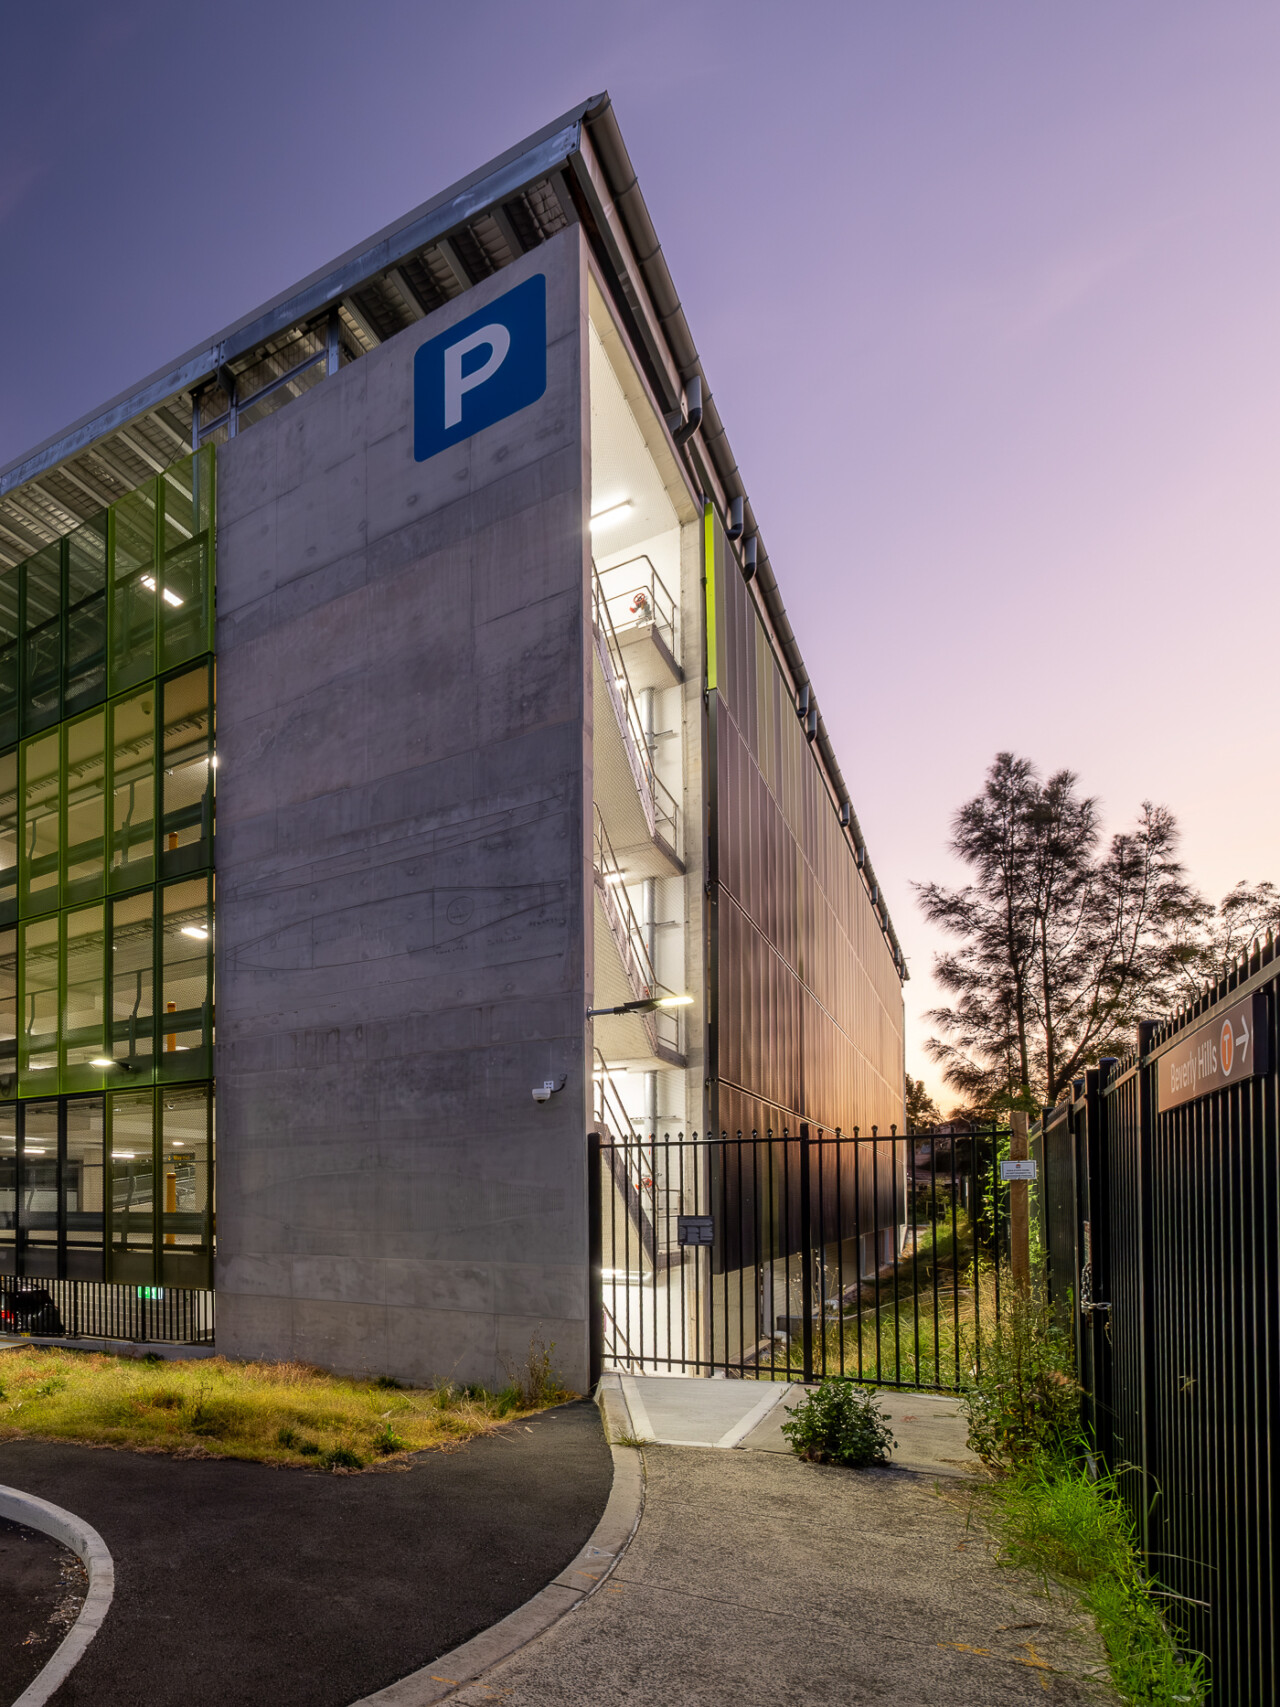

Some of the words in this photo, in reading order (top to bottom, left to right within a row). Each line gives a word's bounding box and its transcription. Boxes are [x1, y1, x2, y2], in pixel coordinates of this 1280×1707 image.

[444, 323, 511, 430] P
[1170, 1051, 1197, 1093] Beverly
[1198, 1039, 1217, 1079] Hills
[1224, 1034, 1230, 1064] T
